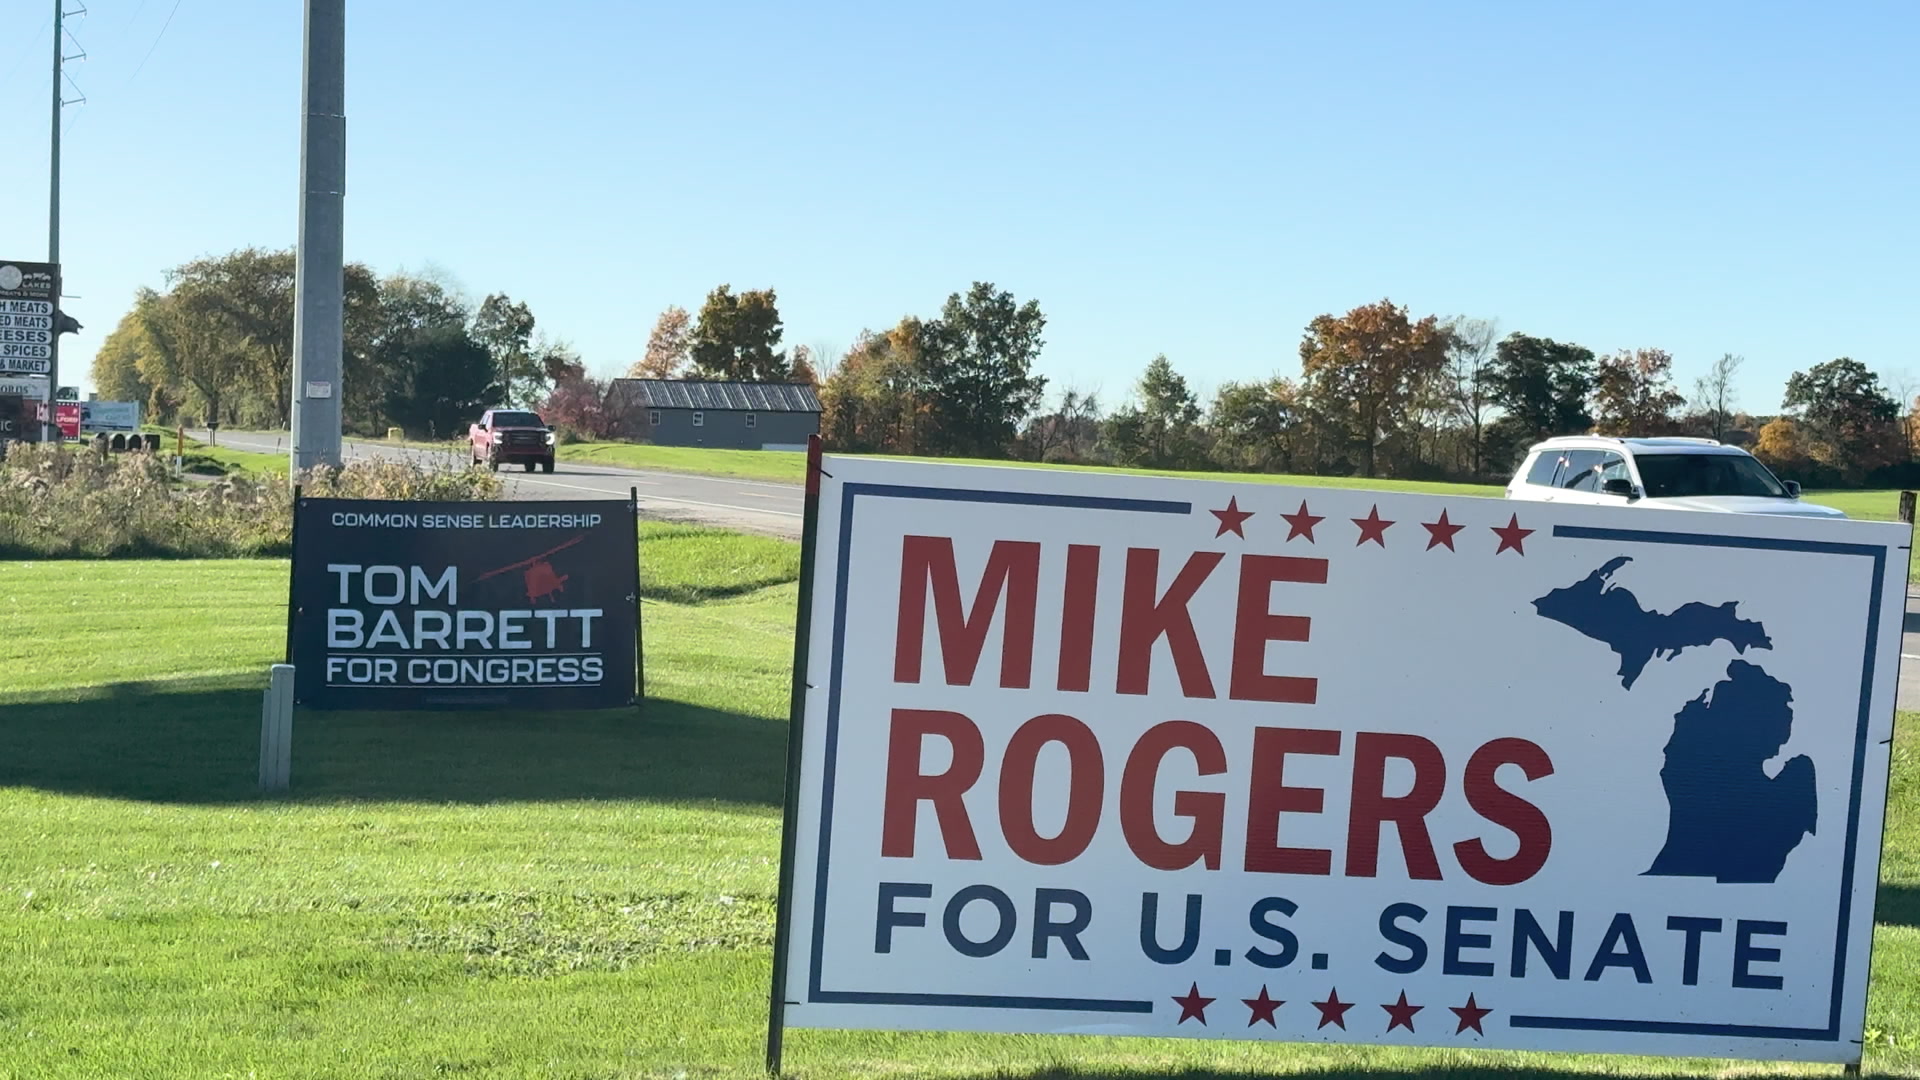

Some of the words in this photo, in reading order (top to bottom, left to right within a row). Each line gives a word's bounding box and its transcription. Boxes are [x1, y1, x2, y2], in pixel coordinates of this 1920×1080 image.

[10, 301, 48, 314] MEATS
[14, 316, 48, 328] MEATS
[0, 330, 47, 343] ESES
[3, 344, 47, 357] SPICES
[8, 359, 46, 372] MARKET
[331, 512, 418, 528] COMMON
[422, 514, 485, 529] SENSE
[488, 513, 602, 529] LEADERSHIP
[327, 563, 458, 606] TOM
[327, 608, 604, 650] BARRETT
[894, 535, 1329, 704] MIKE
[326, 657, 398, 683] FOR
[407, 657, 604, 684] CONGRESS
[882, 708, 1554, 886] ROGERS
[875, 882, 1092, 960] FOR
[1140, 892, 1328, 970] U.S.
[1374, 902, 1788, 990] SENATE
